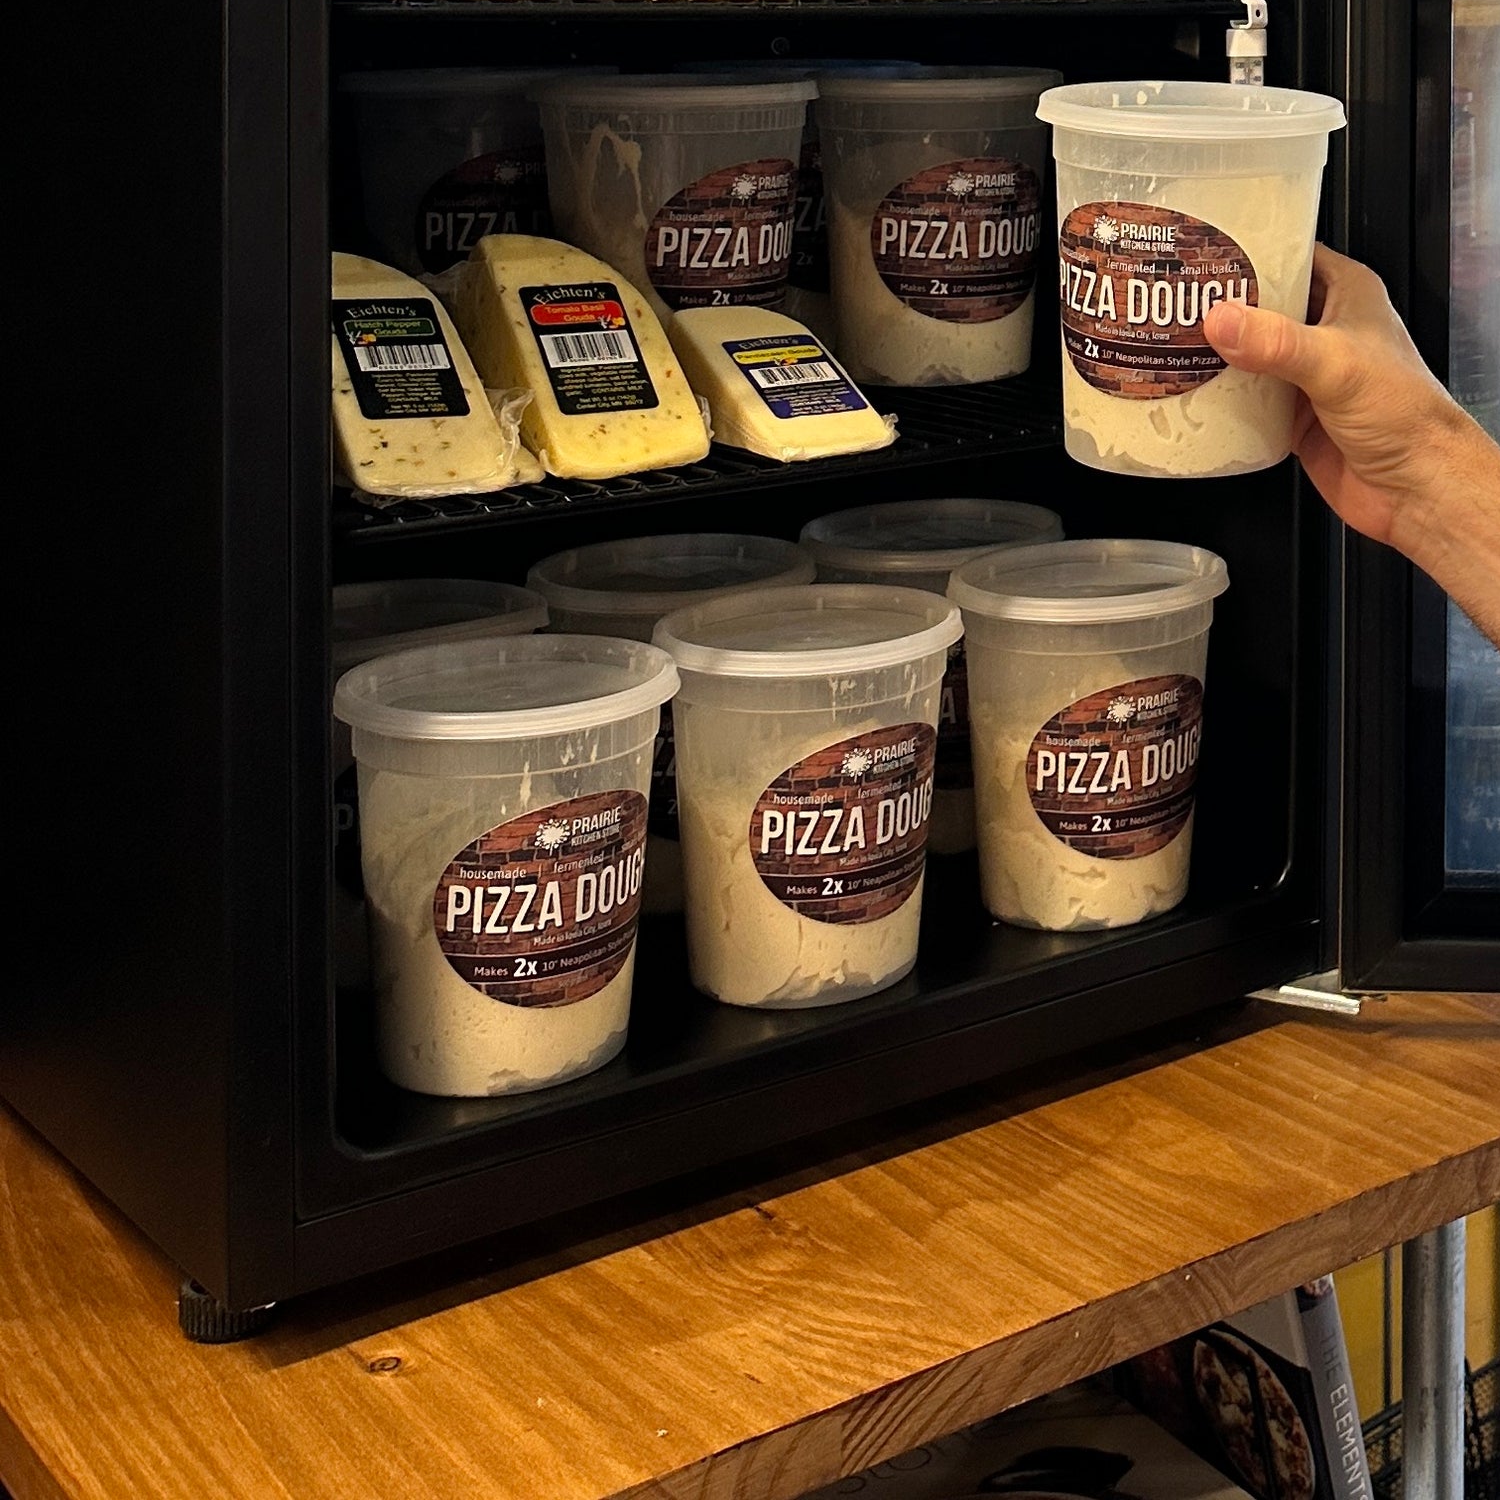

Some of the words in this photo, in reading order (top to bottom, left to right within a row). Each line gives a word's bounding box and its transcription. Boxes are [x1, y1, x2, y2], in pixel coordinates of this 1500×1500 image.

[975, 172, 1016, 189] PRAIRIE
[889, 204, 941, 216] housemade
[961, 204, 1003, 216] fermented
[656, 226, 750, 268] PIZZA
[757, 216, 795, 265] DOU
[879, 217, 969, 260] PIZZA
[1120, 222, 1176, 242] PRAIRIE
[1120, 240, 1151, 252] KITCHEN
[1151, 241, 1176, 253] STORE
[1106, 257, 1156, 275] fermented
[1179, 262, 1241, 276] small-batch
[533, 287, 606, 306] Eichten's
[900, 282, 927, 293] Makes
[929, 279, 949, 295] 2x
[1060, 257, 1118, 321] PIZZA
[712, 289, 731, 306] 2x
[347, 304, 417, 319] Eichten's
[544, 305, 581, 314] Tomato
[563, 313, 596, 323] Gouda
[354, 320, 382, 329] Hatch
[385, 320, 421, 329] Pepper
[739, 336, 799, 351] Eichten's
[1084, 337, 1100, 359] 2x
[1192, 355, 1221, 366] Pizzas
[736, 350, 786, 360] Parmesan
[1137, 687, 1180, 712] PRAIRIE
[1046, 735, 1101, 747] housemade
[1122, 727, 1166, 744] fermented
[873, 736, 919, 764] PRAIRIE
[1036, 749, 1132, 794] PIZZA
[1141, 722, 1200, 788] DOUG
[773, 793, 834, 805] housemade
[857, 780, 902, 800] fermented
[572, 806, 622, 836] PRAIRIE
[761, 805, 866, 856] PIZZA
[876, 776, 935, 846] DOUG
[1059, 820, 1088, 831] Makes
[1091, 815, 1112, 833] 2x
[571, 832, 601, 847] KITCHEN
[601, 824, 621, 840] STORE
[459, 866, 527, 880] housemade
[553, 853, 605, 874] fermented
[786, 884, 818, 896] Makes
[821, 877, 844, 896] 2x
[446, 881, 563, 934] PIZZA
[533, 936, 556, 947] Made
[474, 965, 508, 978] Makes
[513, 957, 538, 978] 2x
[542, 959, 558, 972] 10"
[1320, 1332, 1343, 1382] THE
